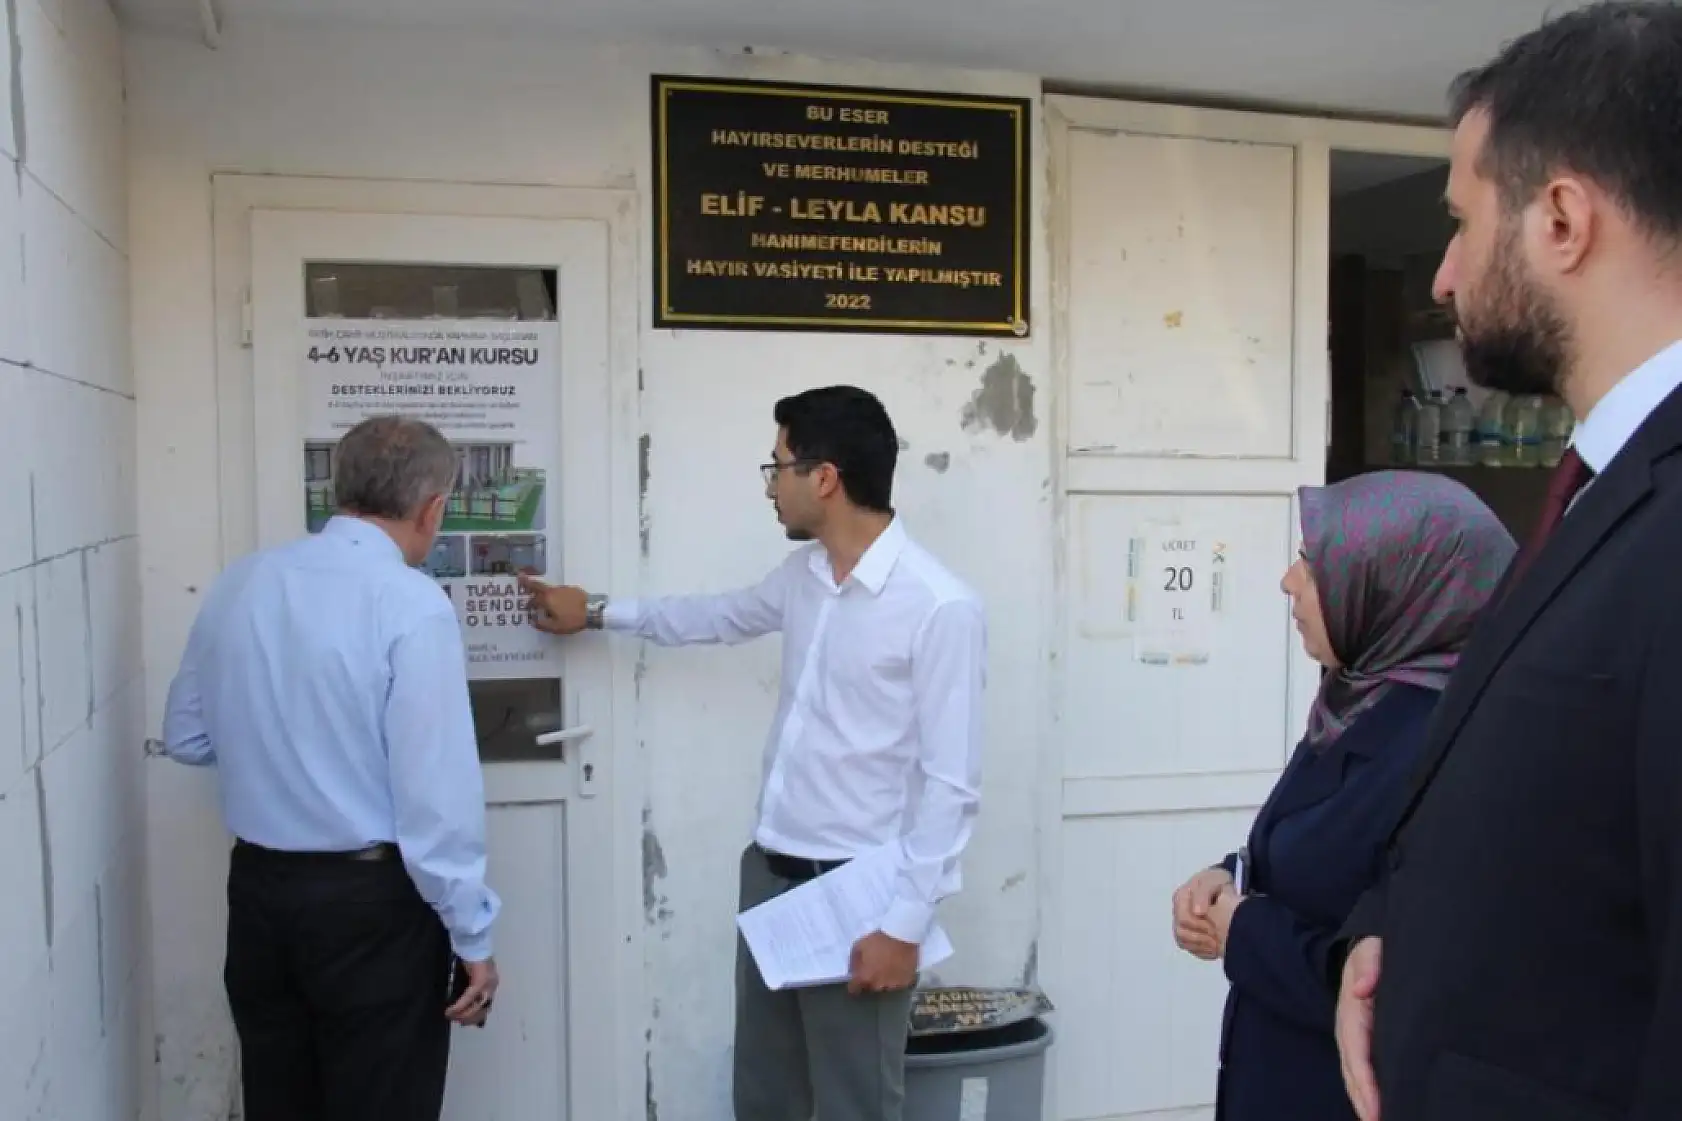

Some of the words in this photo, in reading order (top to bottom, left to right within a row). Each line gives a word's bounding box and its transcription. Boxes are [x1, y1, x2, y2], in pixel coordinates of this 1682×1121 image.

[806, 105, 833, 121] BU
[839, 107, 889, 124] ESER
[711, 128, 893, 153] HAYIRSEVERLERİN
[898, 139, 978, 159] DESTEĞİ
[763, 163, 789, 179] VE
[795, 164, 929, 184] MERHUMELER
[701, 190, 764, 217] ELİF
[790, 197, 881, 222] LEYLA
[889, 203, 986, 226] KANSU
[751, 232, 942, 256] HANIMEFENDİLERİN
[687, 259, 748, 277] HAYIR
[752, 260, 843, 280] VASİYETİ
[849, 262, 878, 282] İLE
[884, 266, 1003, 289] YAPILMIŞTIR
[825, 293, 871, 309] 2022
[307, 346, 339, 364] 4-6
[343, 347, 385, 368] YAŞ
[391, 347, 465, 365] KUR'AN
[471, 348, 539, 366] KURSU
[466, 581, 514, 596] TUĞLA
[1164, 566, 1193, 591] 20
[466, 600, 534, 612] SENDE
[1172, 607, 1184, 620] TL
